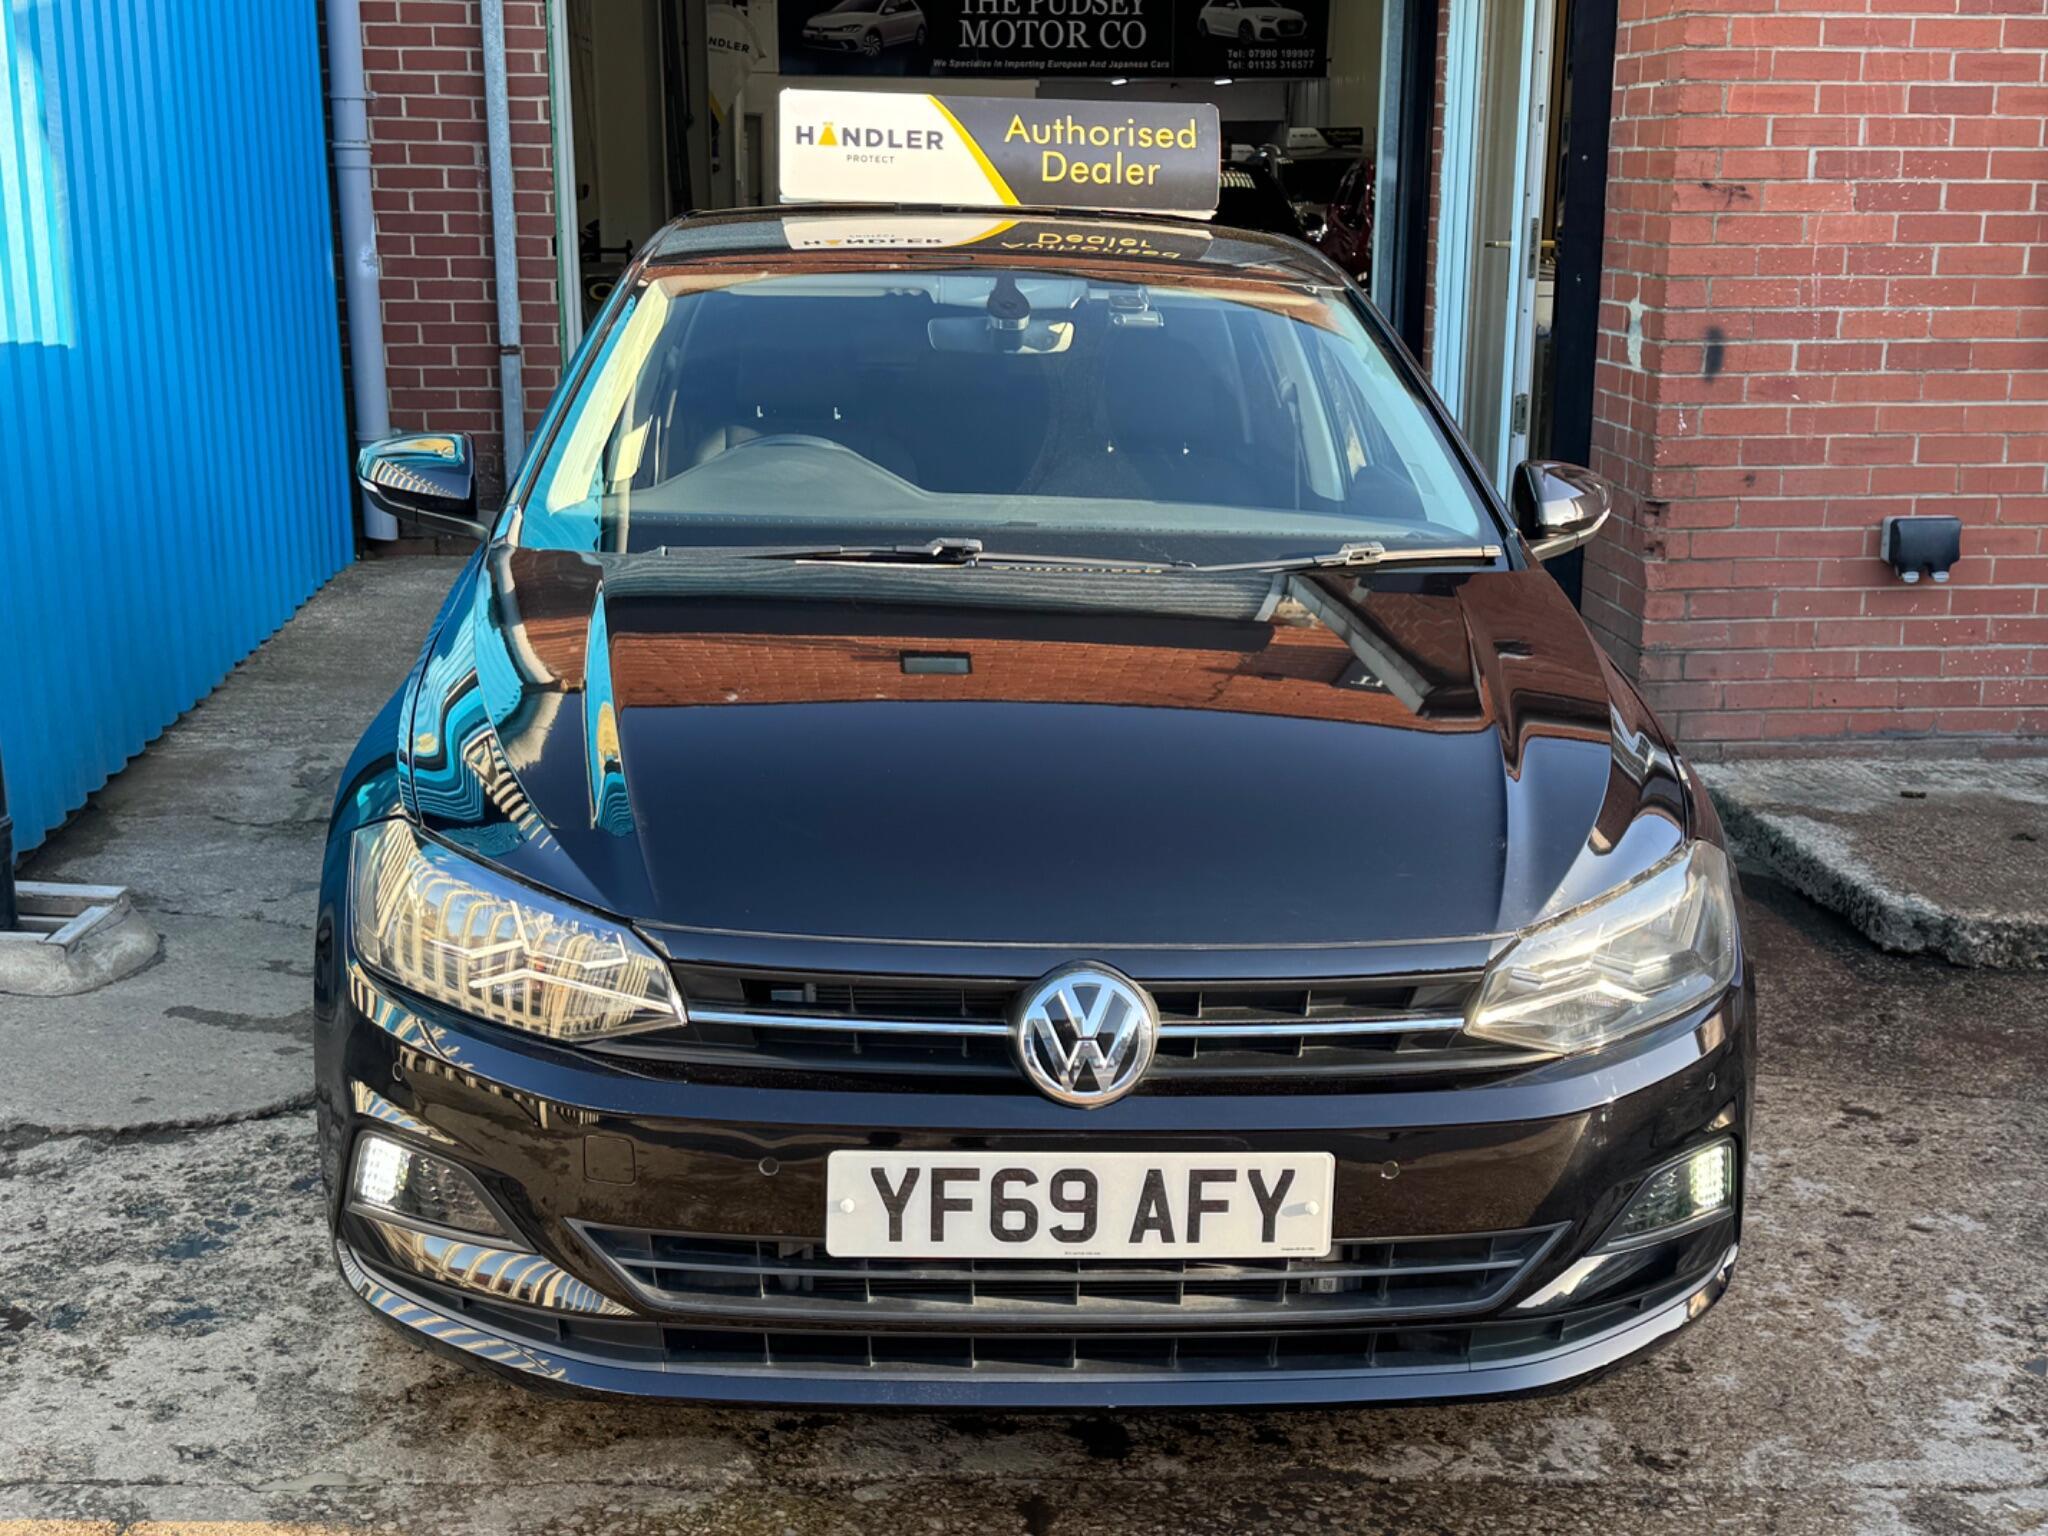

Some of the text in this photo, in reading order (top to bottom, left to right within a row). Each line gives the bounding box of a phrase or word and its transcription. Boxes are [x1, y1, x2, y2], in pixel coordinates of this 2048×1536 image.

[708, 36, 751, 54] NDLER
[958, 19, 1147, 49] MOTOR CO
[932, 58, 948, 68] We
[1004, 59, 1046, 70] Importing
[1047, 59, 1088, 70] European
[1089, 59, 1107, 68] And
[1108, 60, 1149, 70] Japanese
[1150, 60, 1170, 69] Cars
[1003, 113, 1198, 149] Authorised
[845, 153, 895, 164] PROTECT
[1041, 150, 1161, 185] Dealer
[870, 1166, 1296, 1244] YF69 AFY
